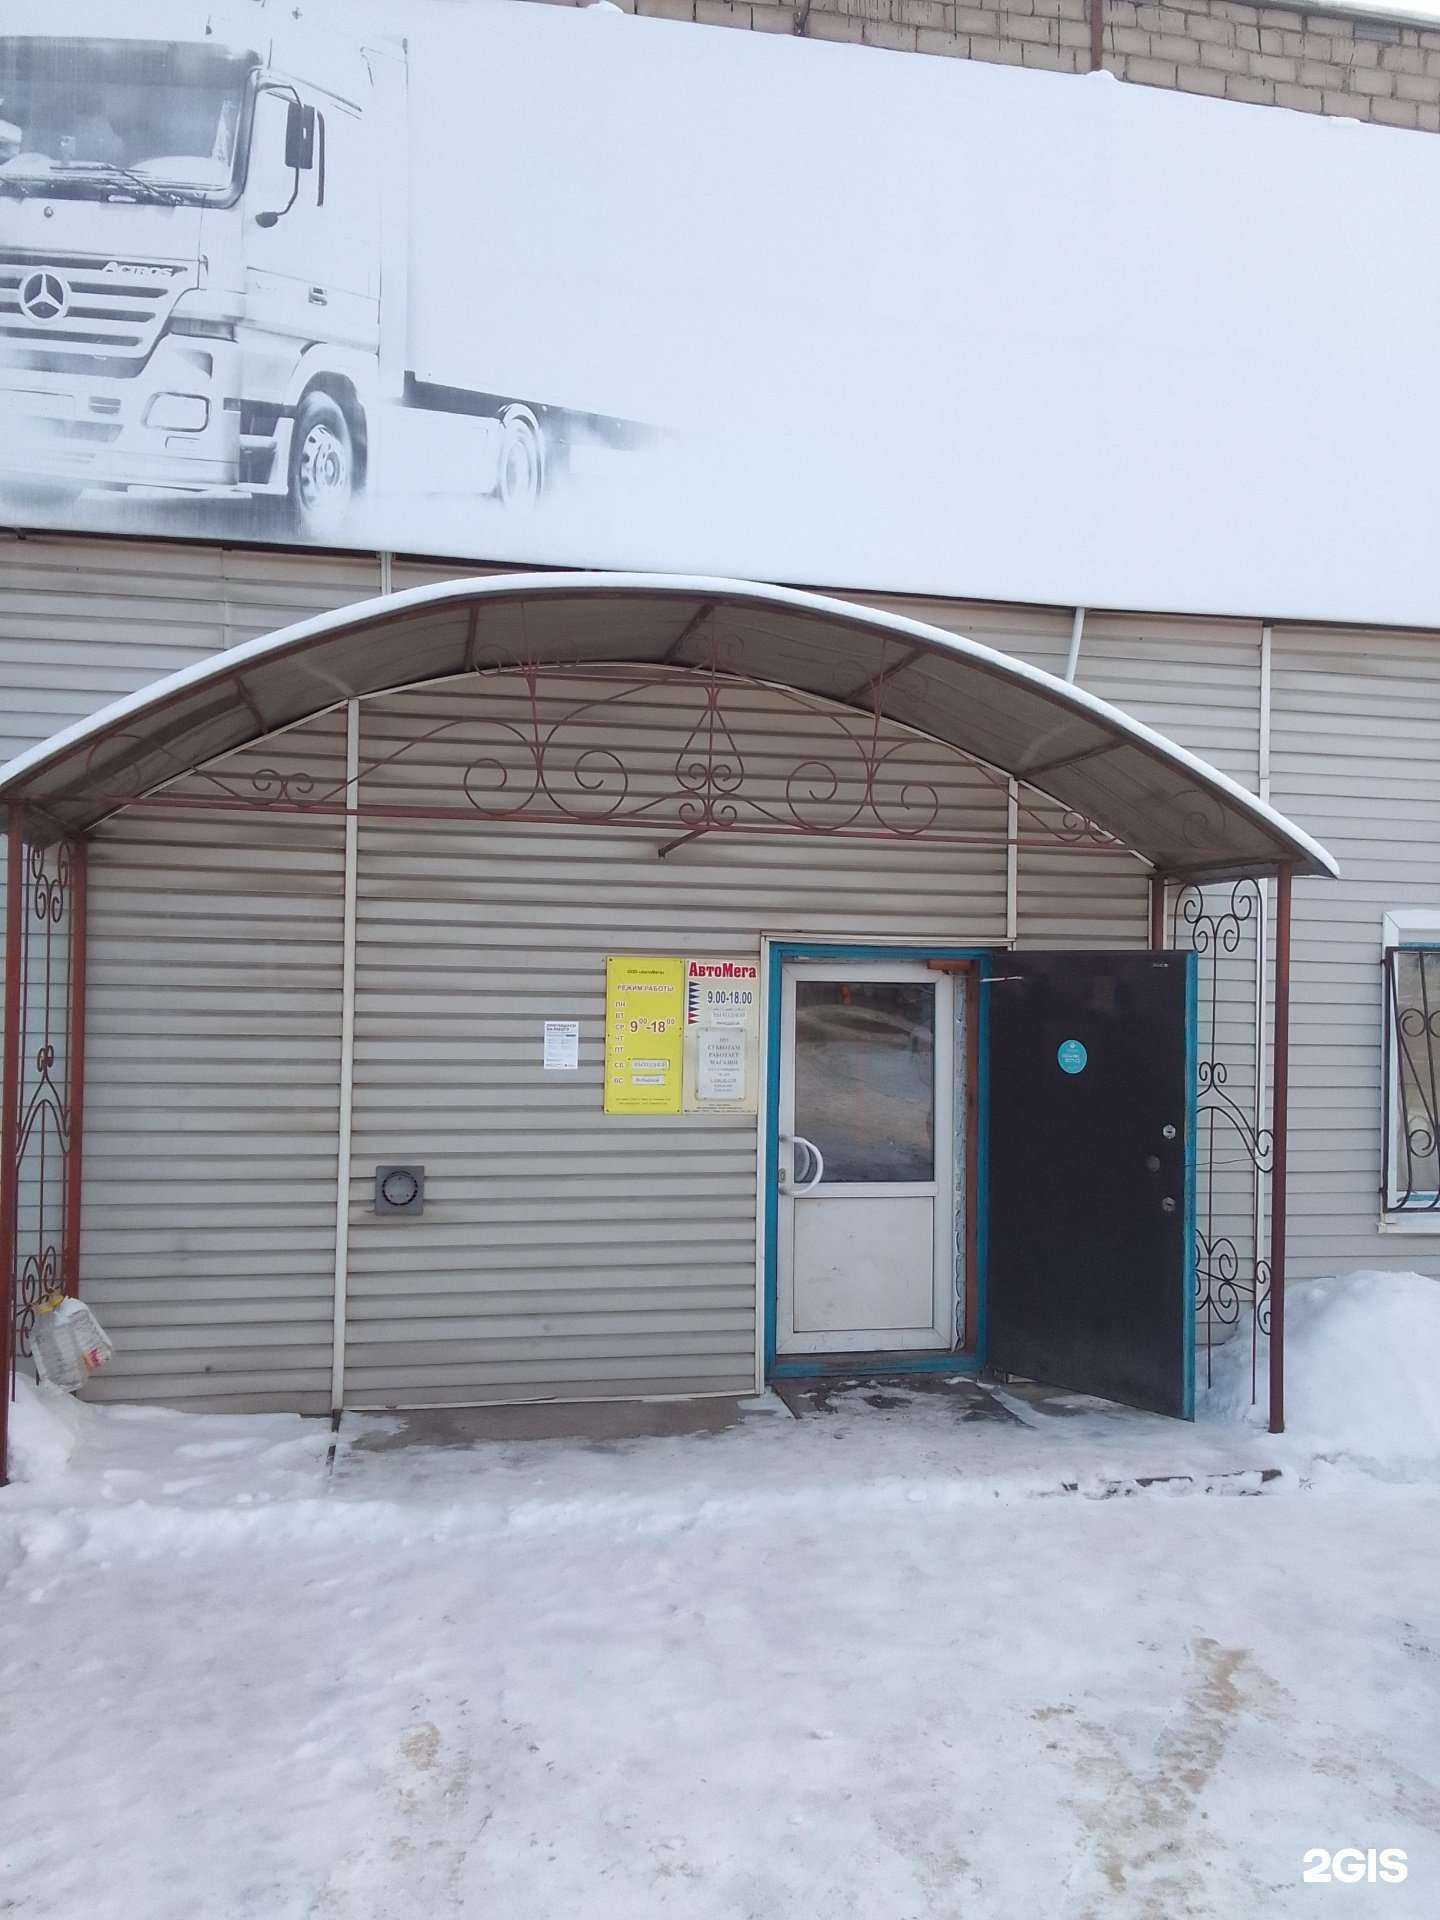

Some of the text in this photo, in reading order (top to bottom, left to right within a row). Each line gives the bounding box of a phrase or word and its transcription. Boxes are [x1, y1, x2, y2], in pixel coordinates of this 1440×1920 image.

[688, 961, 757, 978] АвтоМега
[617, 984, 674, 992] РЕЖИМ РАБОТЫ
[706, 990, 753, 1005] 9.00-18.00
